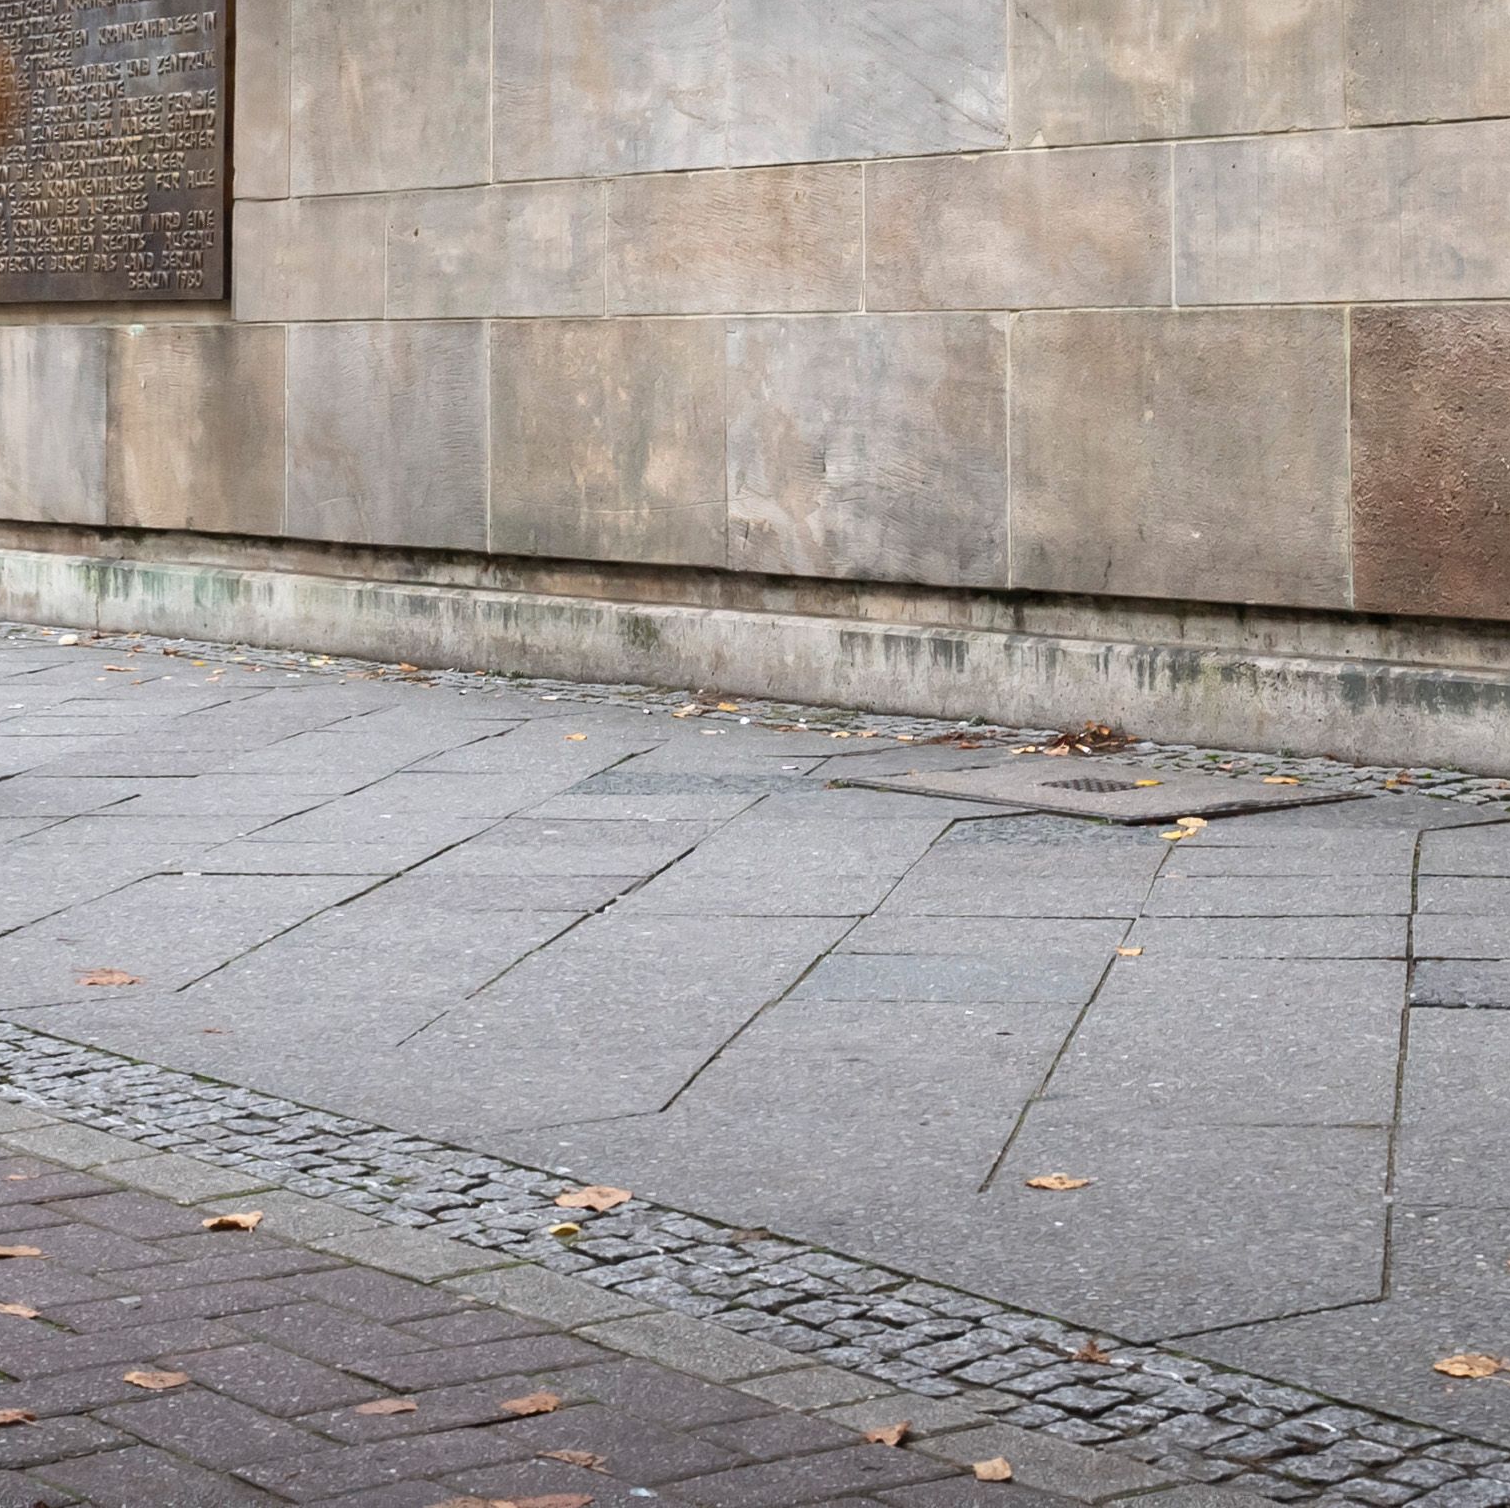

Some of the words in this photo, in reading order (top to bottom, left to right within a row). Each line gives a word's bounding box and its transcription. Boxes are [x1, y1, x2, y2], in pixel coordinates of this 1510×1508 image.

[2, 36, 22, 56] DES
[98, 12, 197, 44] KRANKENHAUSES
[202, 10, 216, 31] IN
[20, 48, 71, 72] STRASSE
[37, 61, 120, 88] KRANKENHAUS
[125, 57, 150, 78] UND
[156, 49, 216, 75] ZENTRUM
[55, 79, 124, 104] FORSCHUNG
[31, 102, 87, 125] SPERRUNG
[91, 99, 111, 119] DES
[118, 94, 163, 116] HAUSES
[195, 88, 216, 109] DIE
[31, 118, 113, 144] ZUNEHMENDEM
[121, 113, 161, 136] MASSE
[166, 108, 216, 132] GHETTO
[62, 134, 142, 159] ABTRANSPORT
[16, 163, 34, 181] DIE
[41, 151, 184, 179] KONZENTRATIONSLAGER
[20, 180, 41, 199] DES
[47, 172, 145, 197] KRANKENHAUSES
[187, 167, 216, 189] ALLE
[10, 198, 50, 218] BEGINN
[57, 196, 78, 216] DES
[12, 214, 95, 236] KRANKENHAUS
[101, 211, 142, 232] BERLIN
[149, 209, 180, 230] WIRD
[187, 207, 216, 228] EINE
[101, 231, 145, 251] RECHTS
[49, 253, 86, 271] DURCH
[93, 252, 117, 270] DAS
[123, 250, 155, 269] LAND
[161, 249, 204, 268] BERLIN
[128, 270, 171, 290] BERLIN
[176, 269, 204, 289] 1980
